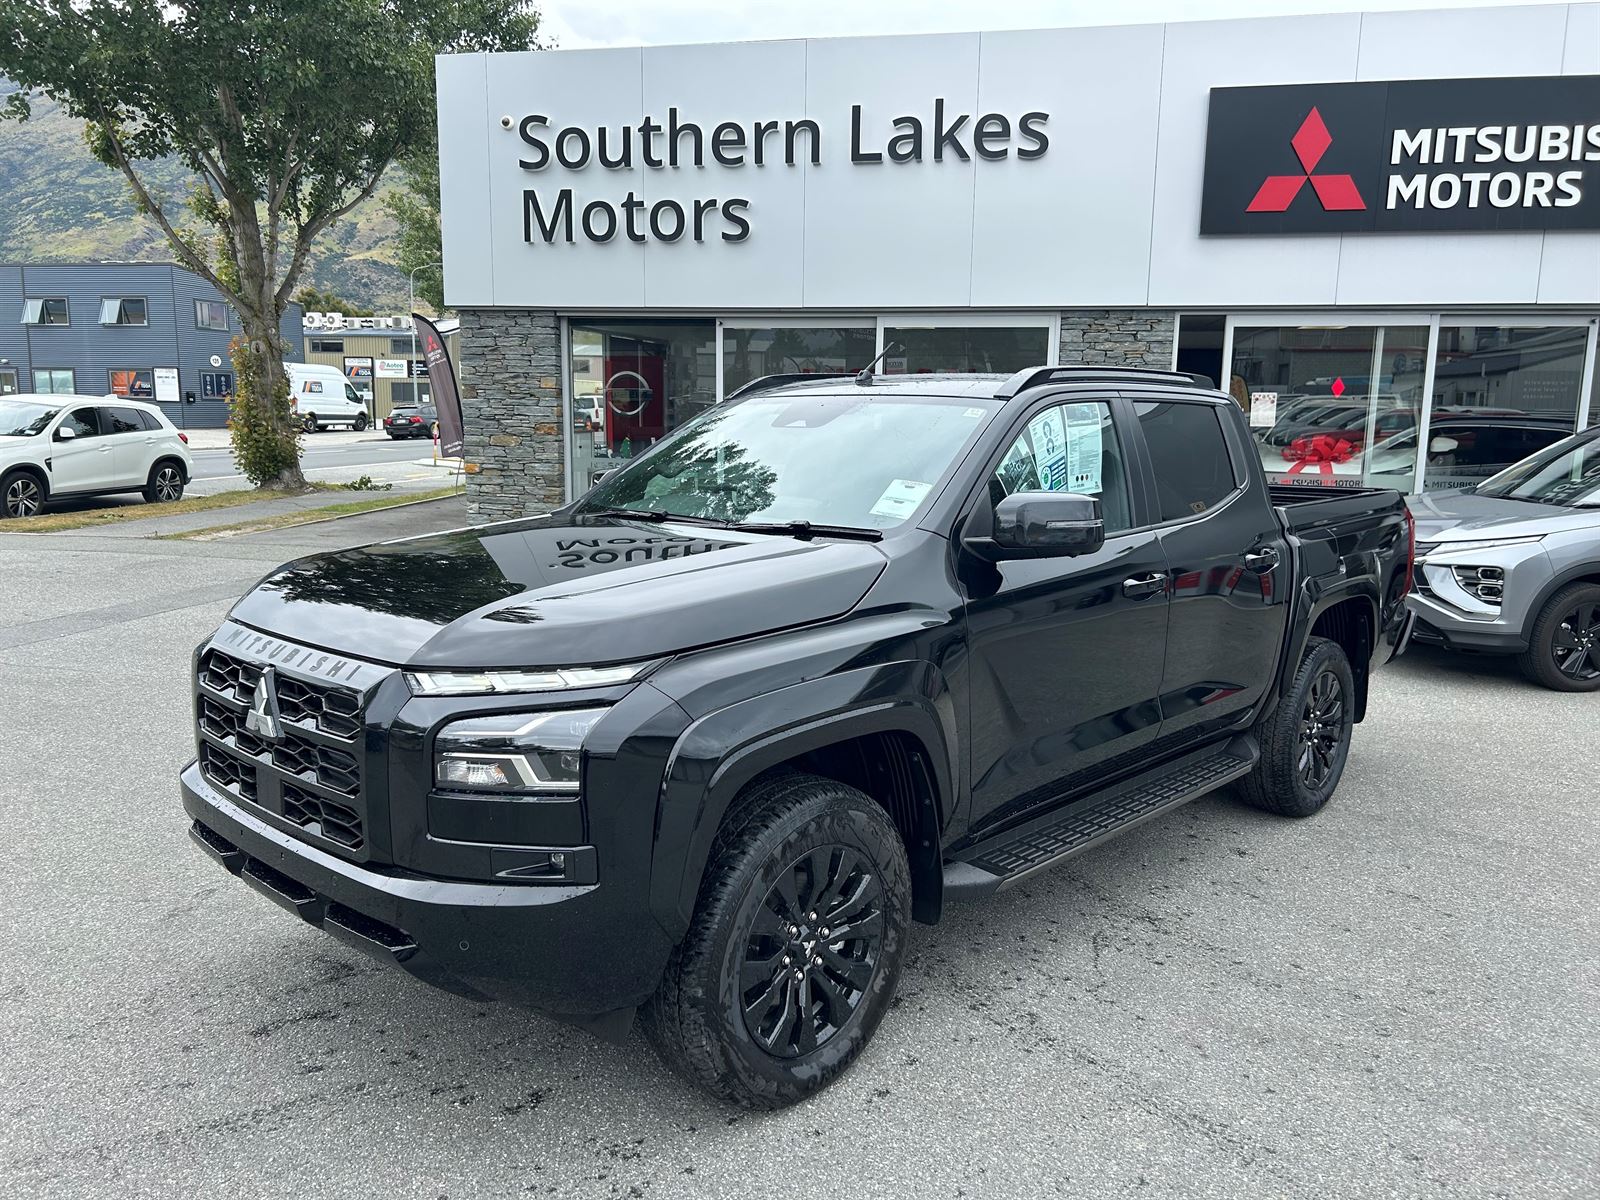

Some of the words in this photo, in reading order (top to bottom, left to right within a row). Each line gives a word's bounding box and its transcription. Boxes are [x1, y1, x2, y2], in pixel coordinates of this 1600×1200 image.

[518, 107, 822, 171] Southern
[850, 98, 1051, 167] Lakes
[522, 188, 752, 245] Motors
[1386, 170, 1583, 211] MOTORS
[225, 628, 362, 682] MITSUBISHI
